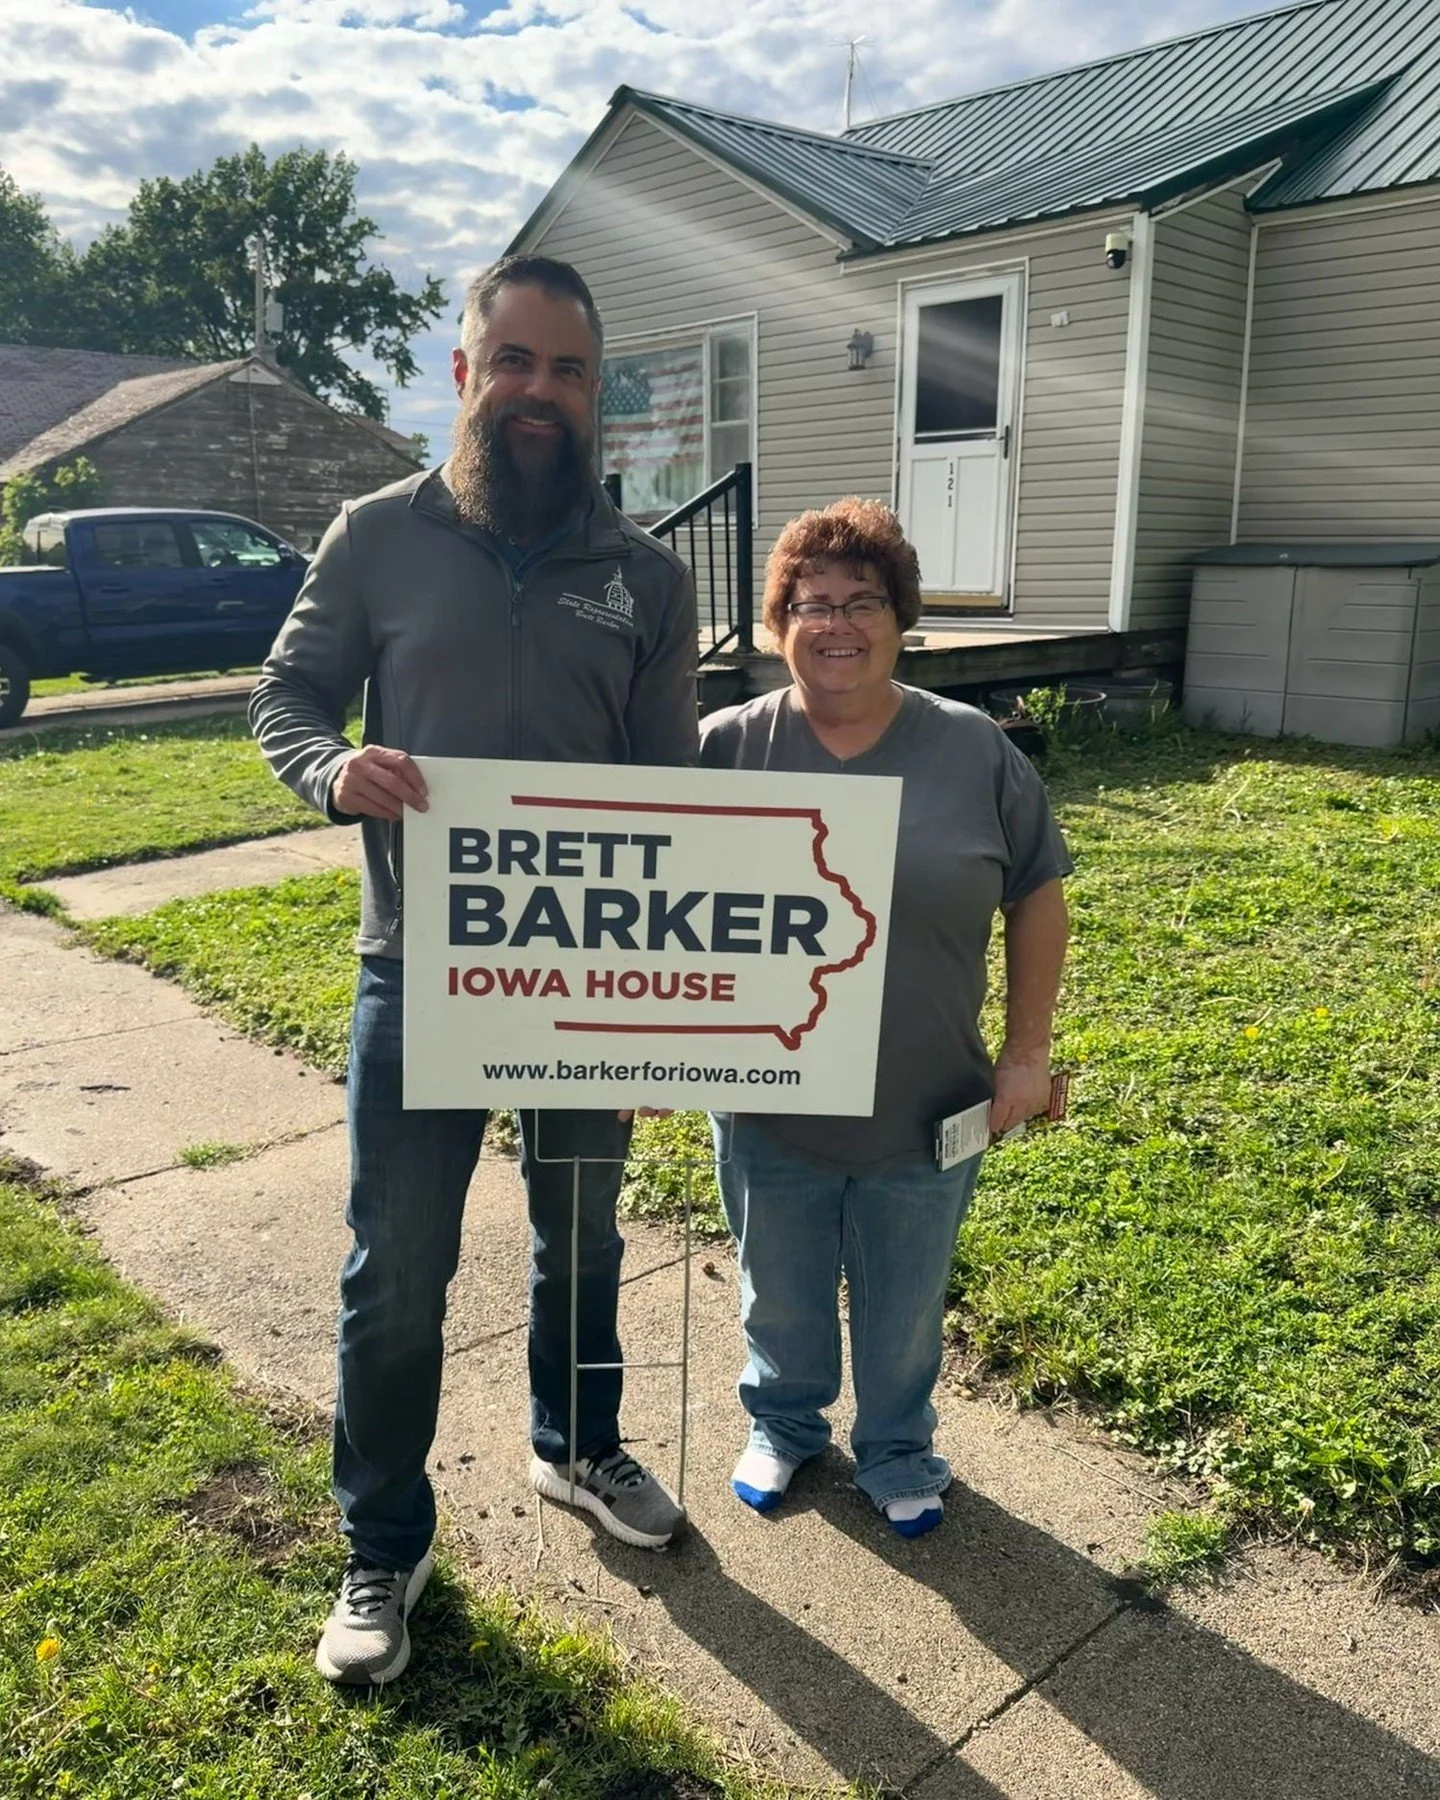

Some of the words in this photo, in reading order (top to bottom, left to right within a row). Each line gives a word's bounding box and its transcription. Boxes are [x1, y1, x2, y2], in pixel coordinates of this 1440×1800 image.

[557, 597, 581, 608] State
[448, 826, 672, 880] BRETT
[448, 883, 829, 957] BARKER
[448, 966, 571, 998] IOWA
[585, 969, 737, 1002] HOUSE
[482, 1059, 801, 1086] www.barkerforiowa.com
